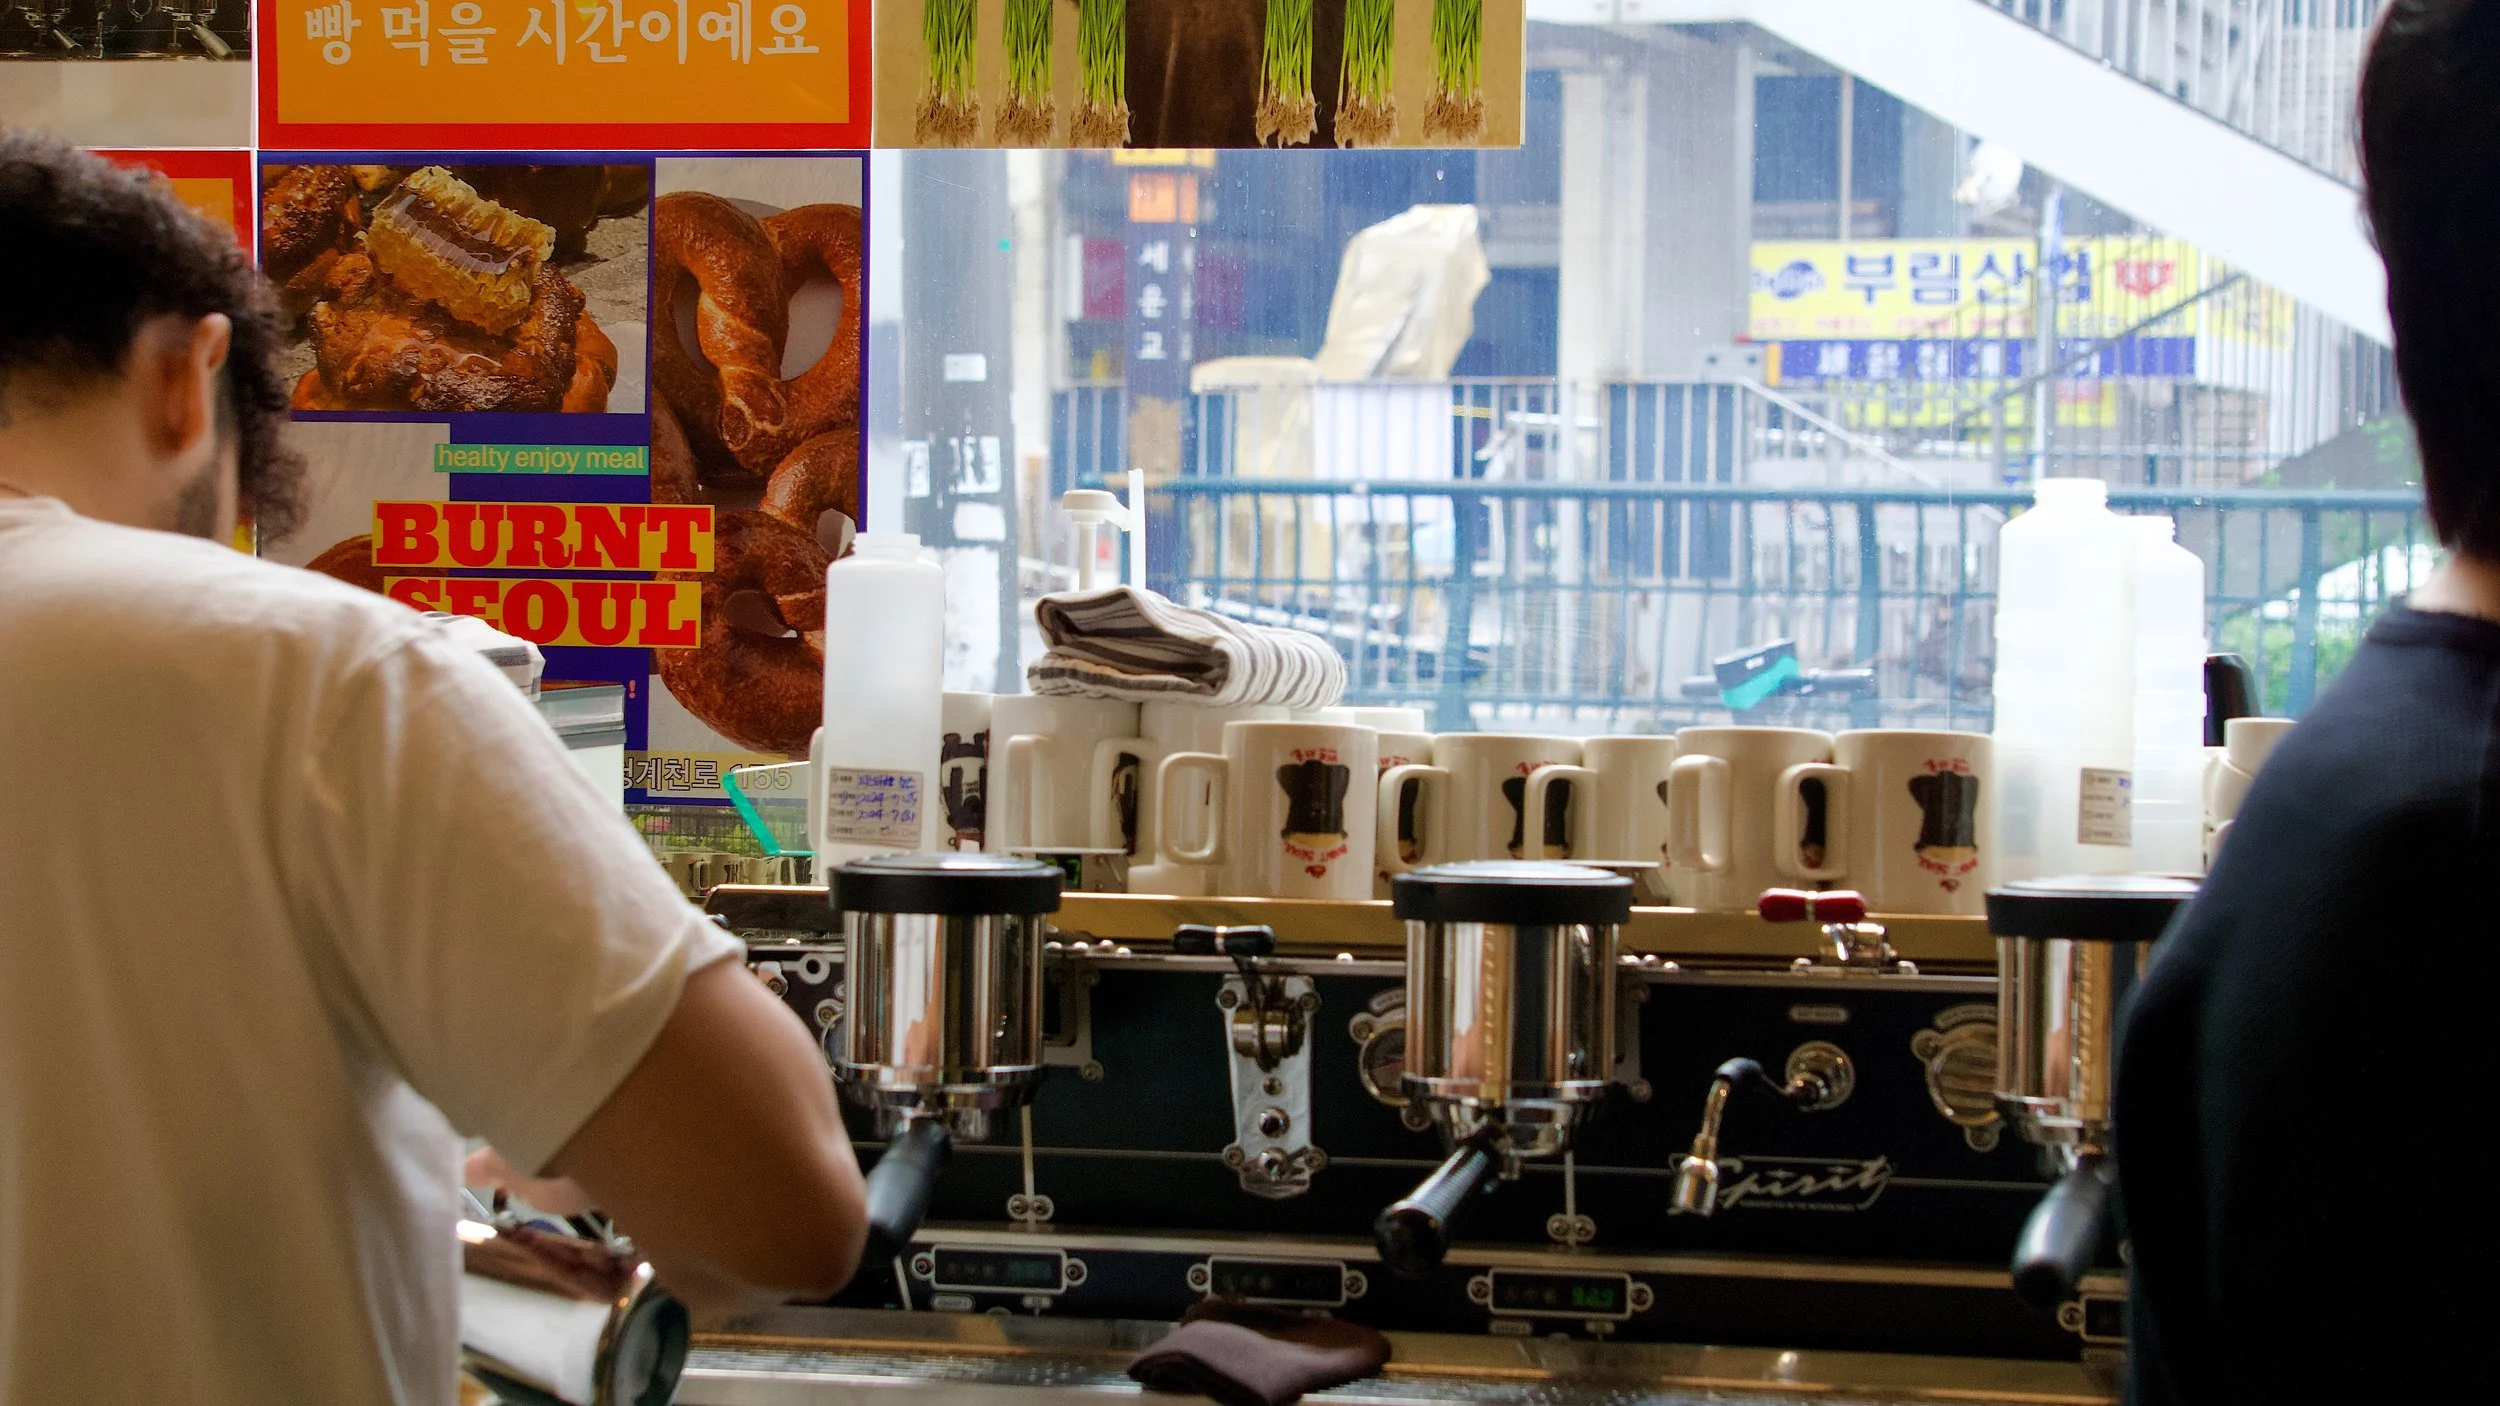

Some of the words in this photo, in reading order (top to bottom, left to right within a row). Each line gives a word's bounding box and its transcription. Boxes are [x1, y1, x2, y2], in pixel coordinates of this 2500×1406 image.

[304, 0, 362, 66] 빵
[381, 0, 497, 66] 먹을
[516, 0, 820, 66] 시간이예요
[438, 444, 510, 473] healty
[515, 446, 580, 474] enjoy
[586, 446, 645, 470] meal
[376, 503, 711, 569] BURNT
[729, 763, 792, 790] 155
